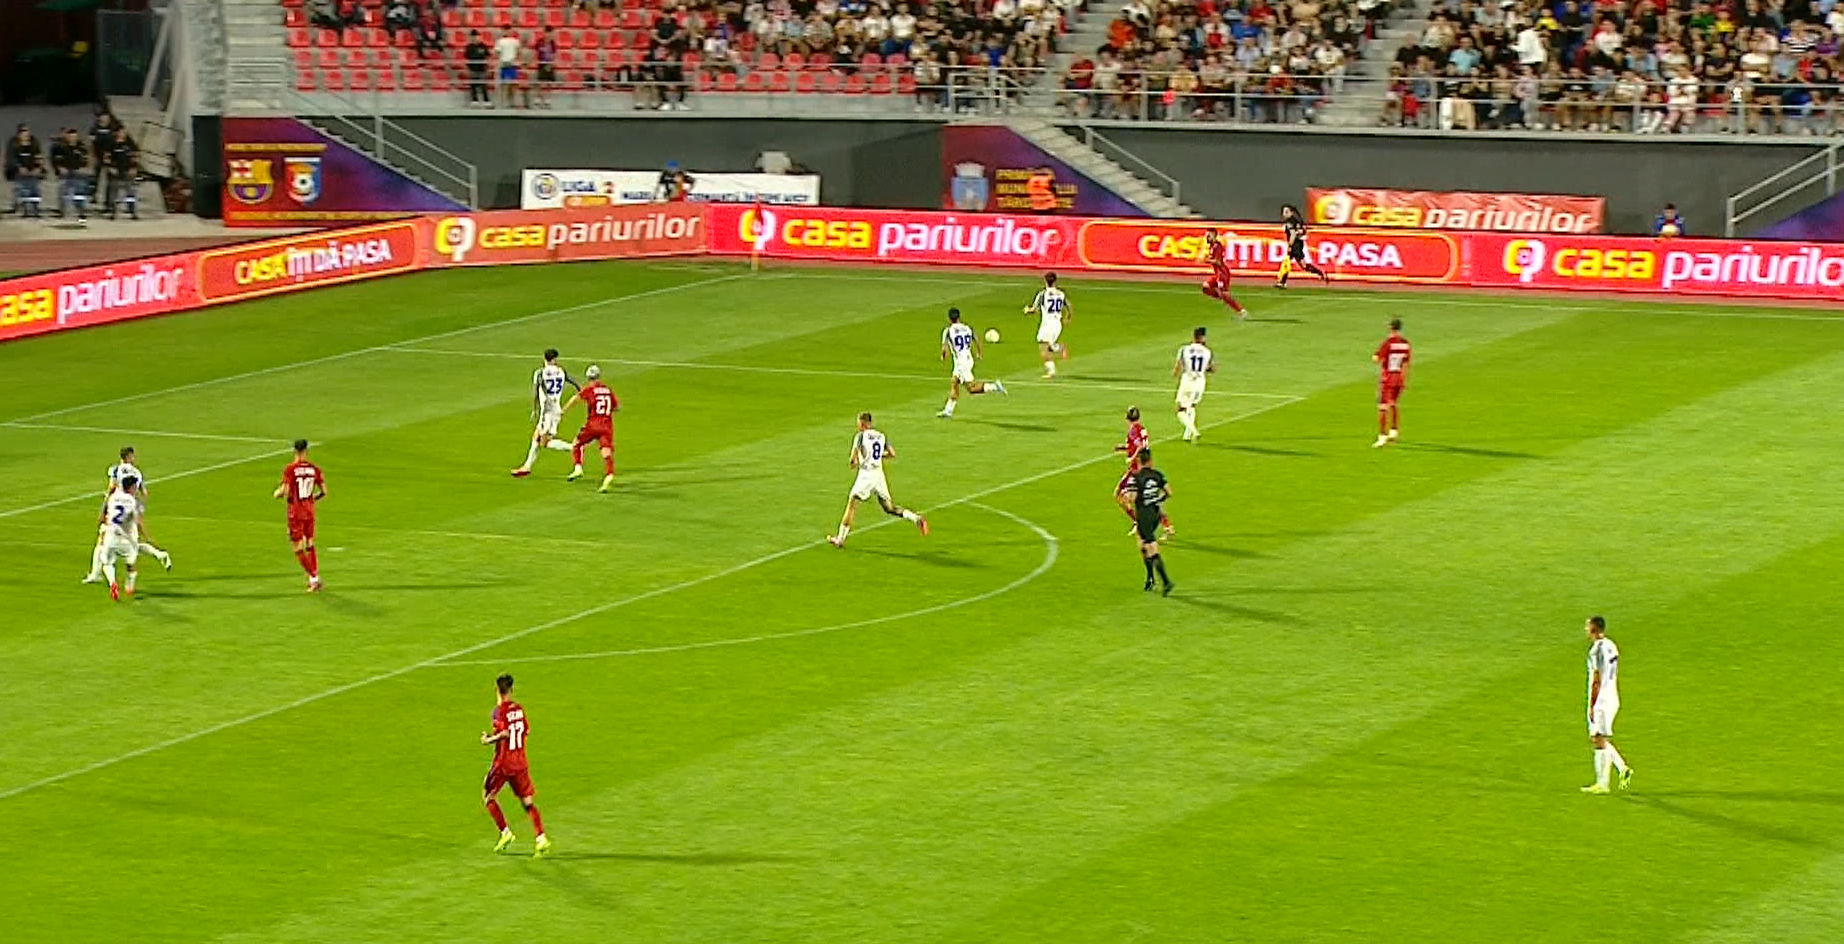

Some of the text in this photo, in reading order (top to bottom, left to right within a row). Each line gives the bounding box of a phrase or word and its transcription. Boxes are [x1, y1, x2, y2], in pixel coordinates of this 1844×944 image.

[1352, 205, 1591, 233] casa pariurilor
[478, 213, 700, 251] casa pariurilor
[783, 217, 1058, 257] casa pariurilor
[234, 253, 288, 285] CASA
[341, 239, 393, 268] PASA
[1318, 241, 1403, 269] PASA
[1553, 248, 1655, 279] casa
[58, 263, 183, 323] pariurilor
[1046, 298, 1063, 314] 20
[954, 333, 972, 352] 99
[1190, 355, 1204, 372] 11
[545, 377, 563, 396] 23
[595, 394, 612, 416] 21
[872, 441, 882, 460] 8
[296, 477, 316, 499] 10
[111, 504, 125, 525] 2
[507, 720, 525, 751] 17
